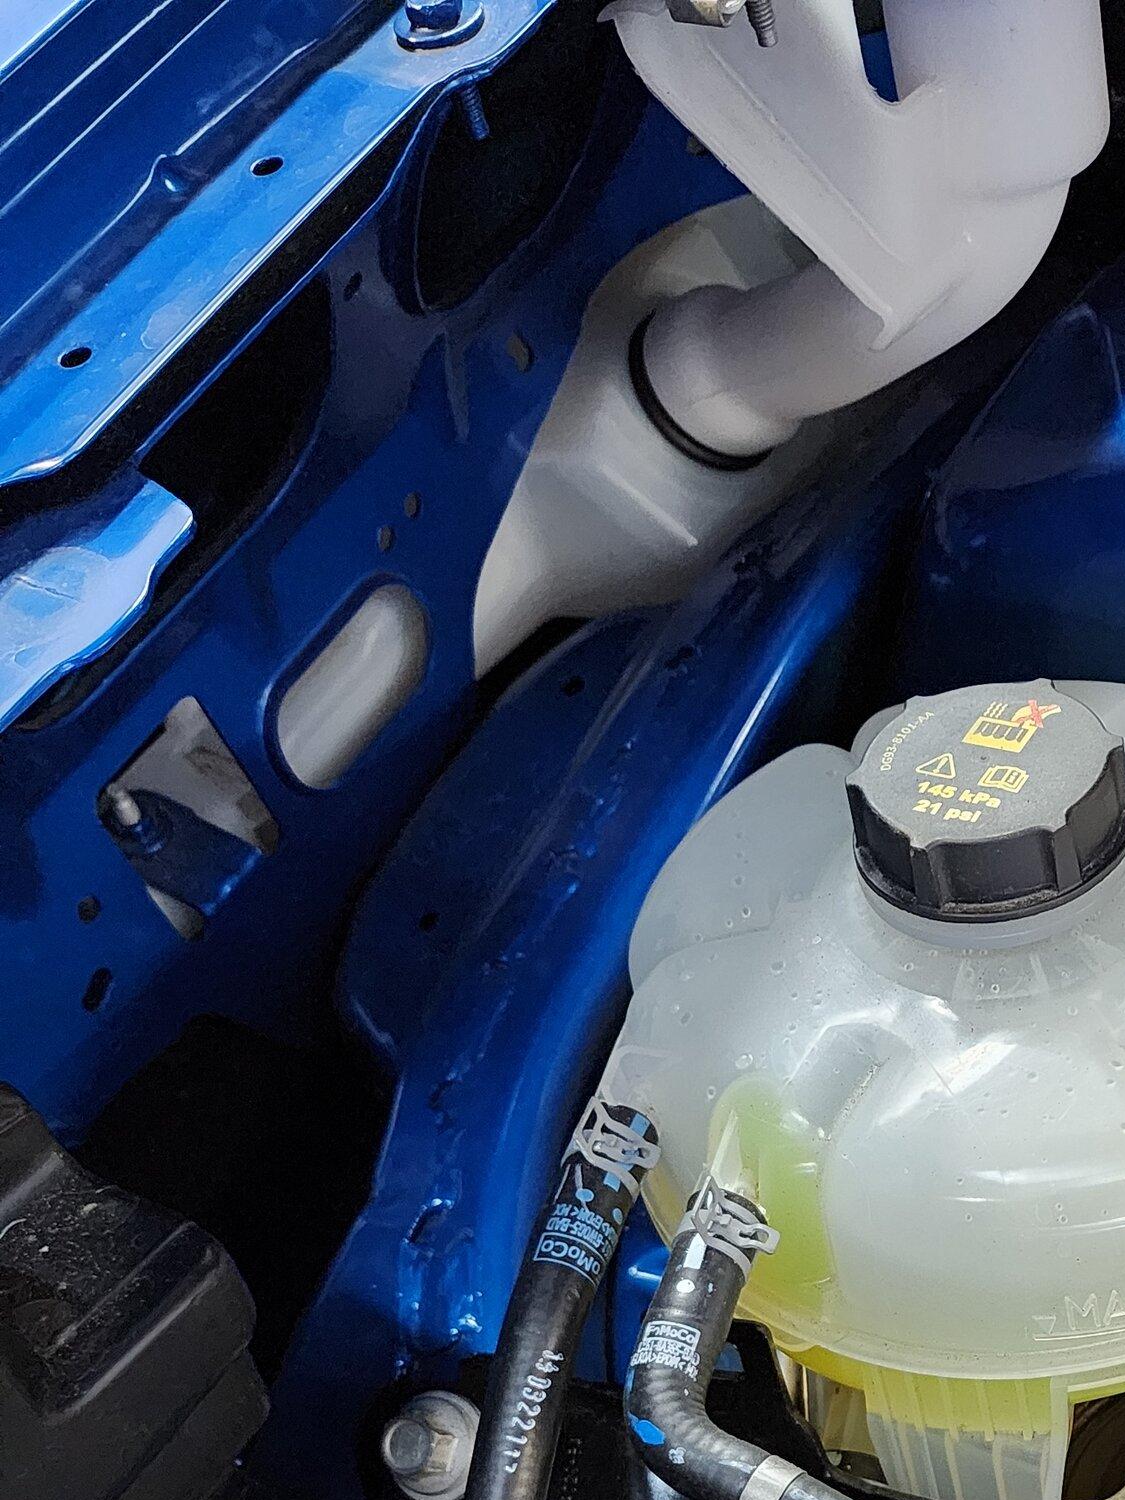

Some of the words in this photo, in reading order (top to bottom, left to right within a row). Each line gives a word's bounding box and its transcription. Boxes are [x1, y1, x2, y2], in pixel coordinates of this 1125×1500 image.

[918, 781, 958, 799] 145
[958, 789, 1002, 809] kPa
[912, 799, 943, 815] 21
[943, 808, 982, 823] psi
[541, 1239, 601, 1275] oMoCo
